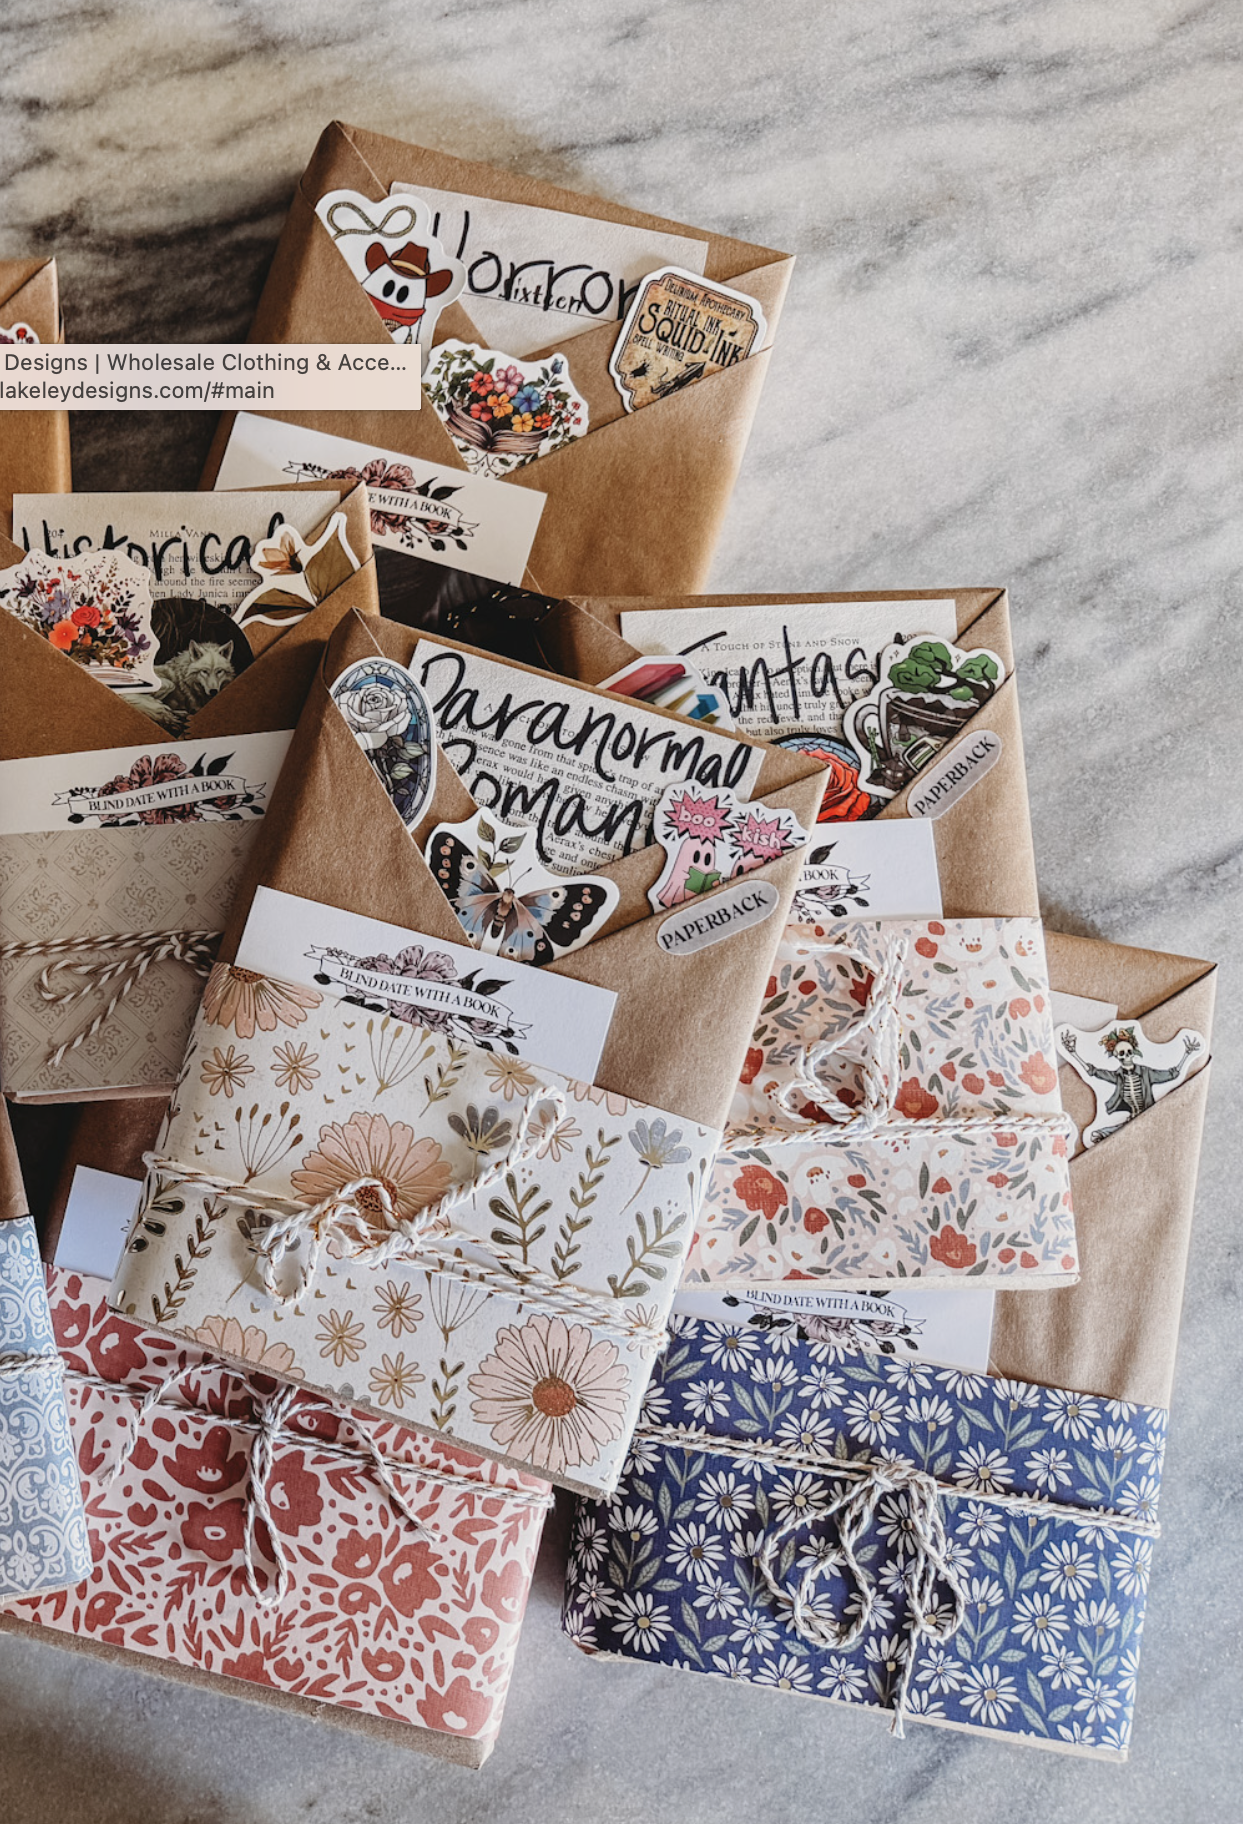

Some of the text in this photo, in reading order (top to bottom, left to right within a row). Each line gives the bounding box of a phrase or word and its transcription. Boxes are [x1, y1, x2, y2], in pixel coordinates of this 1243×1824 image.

[498, 278, 584, 313] ixten
[663, 300, 724, 335] RITUAL INK
[639, 302, 744, 367] SQUID INK
[378, 494, 410, 508] WITH
[409, 500, 418, 510] A
[419, 501, 452, 520] BOOK
[149, 529, 181, 538] MILLA
[154, 577, 187, 587] around
[190, 577, 205, 586] the
[209, 576, 225, 586] fire
[170, 589, 228, 599] Lady Junica
[701, 637, 860, 652] A TOUCH OF STNE AND SNOW
[678, 625, 904, 724] antas
[421, 652, 752, 788] Paranormal
[738, 716, 753, 725] the
[807, 713, 825, 722] and
[777, 701, 826, 712] unce truly
[765, 727, 785, 736] also
[502, 738, 527, 751] gone
[529, 744, 554, 760] from
[557, 753, 576, 767] that
[618, 774, 639, 788] trap
[641, 782, 654, 792] of
[509, 754, 528, 765] was
[530, 758, 549, 772] like
[551, 767, 564, 777] an
[566, 771, 605, 790] endless
[605, 783, 638, 801] chasm
[914, 736, 996, 815] PAPERBACK
[89, 779, 236, 811] BLIND DATE WITH A BOOK
[473, 756, 499, 770] erax
[503, 764, 534, 781] would
[563, 784, 592, 800] given
[595, 794, 629, 811] anythi
[442, 738, 654, 862] oman
[679, 805, 715, 827] boo
[545, 832, 585, 852] Aerax's
[589, 846, 616, 861] chest
[742, 827, 780, 849] kish
[559, 850, 578, 862] and
[803, 869, 839, 881] BOOK
[660, 890, 769, 950] PAPERBACK
[340, 967, 501, 1019] BLIND DATE WITH A BOOK
[746, 1290, 895, 1318] BLIND DATE WITH A BOOK
